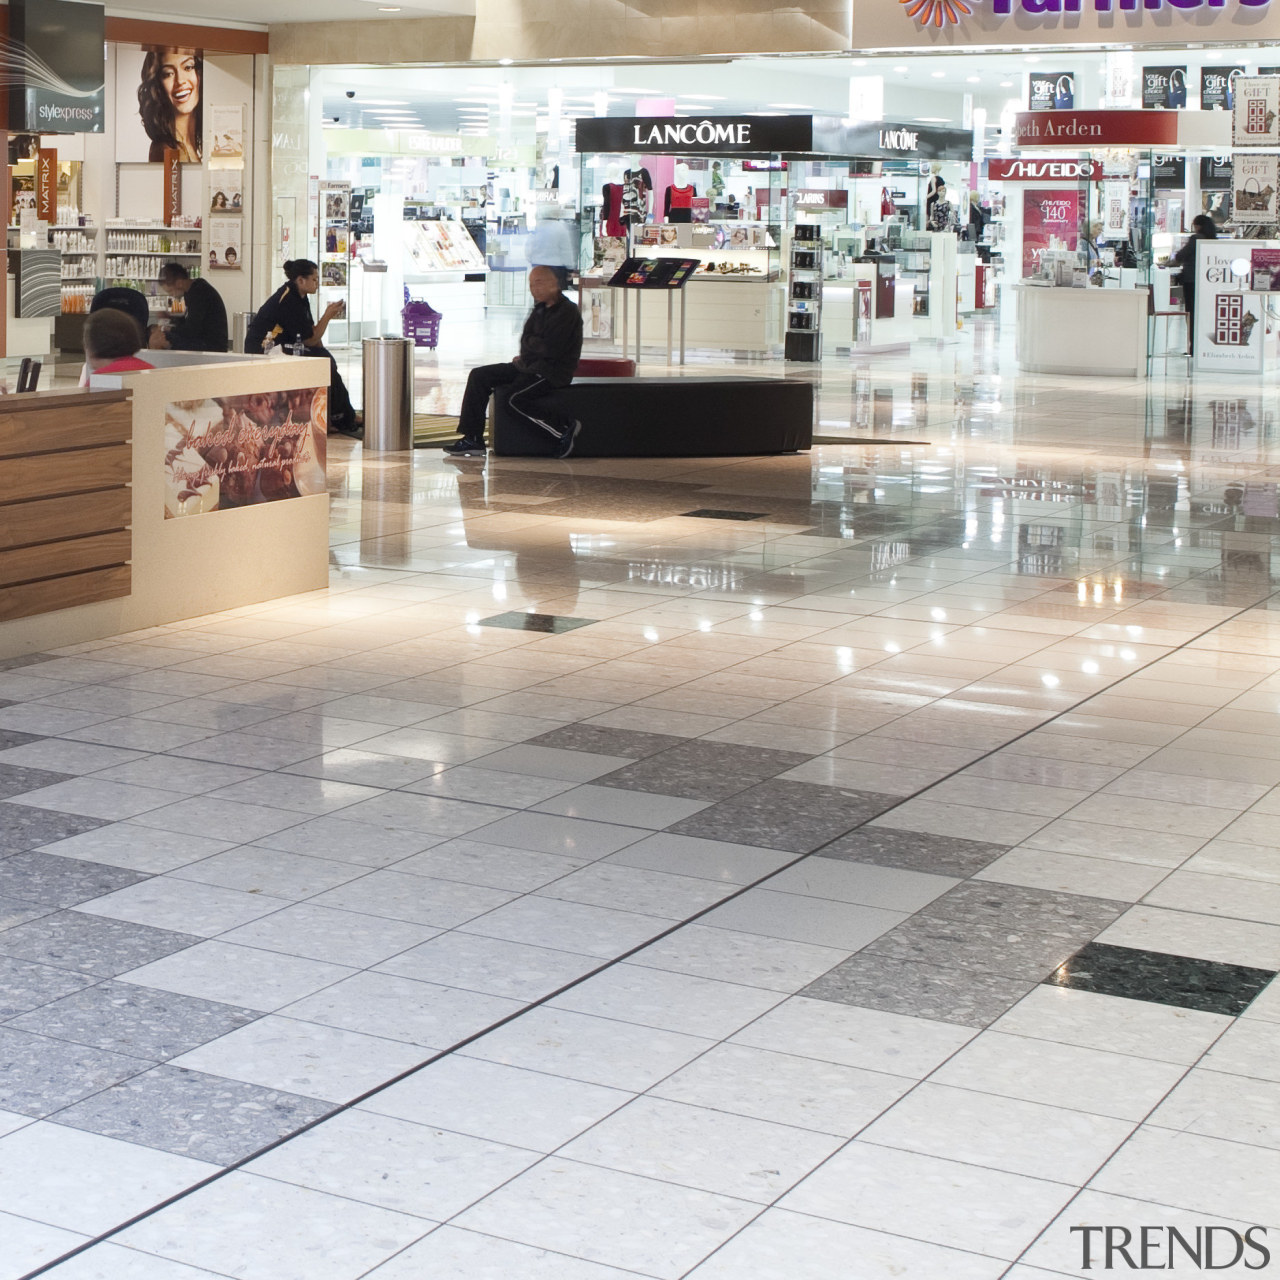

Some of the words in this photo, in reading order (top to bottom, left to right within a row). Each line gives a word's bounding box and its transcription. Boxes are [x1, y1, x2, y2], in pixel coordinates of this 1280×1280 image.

[1147, 76, 1168, 90] gift
[1206, 76, 1227, 90] gift
[40, 104, 93, 122] stylexpress
[633, 120, 751, 144] LANCÔME
[1044, 119, 1102, 136] Arden
[879, 128, 919, 150] LANCÔME
[1001, 161, 1095, 177] SHISEIDO
[42, 158, 50, 213] MATRIX
[1215, 256, 1233, 265] lov
[186, 412, 236, 449] baked
[237, 410, 310, 458] everyday
